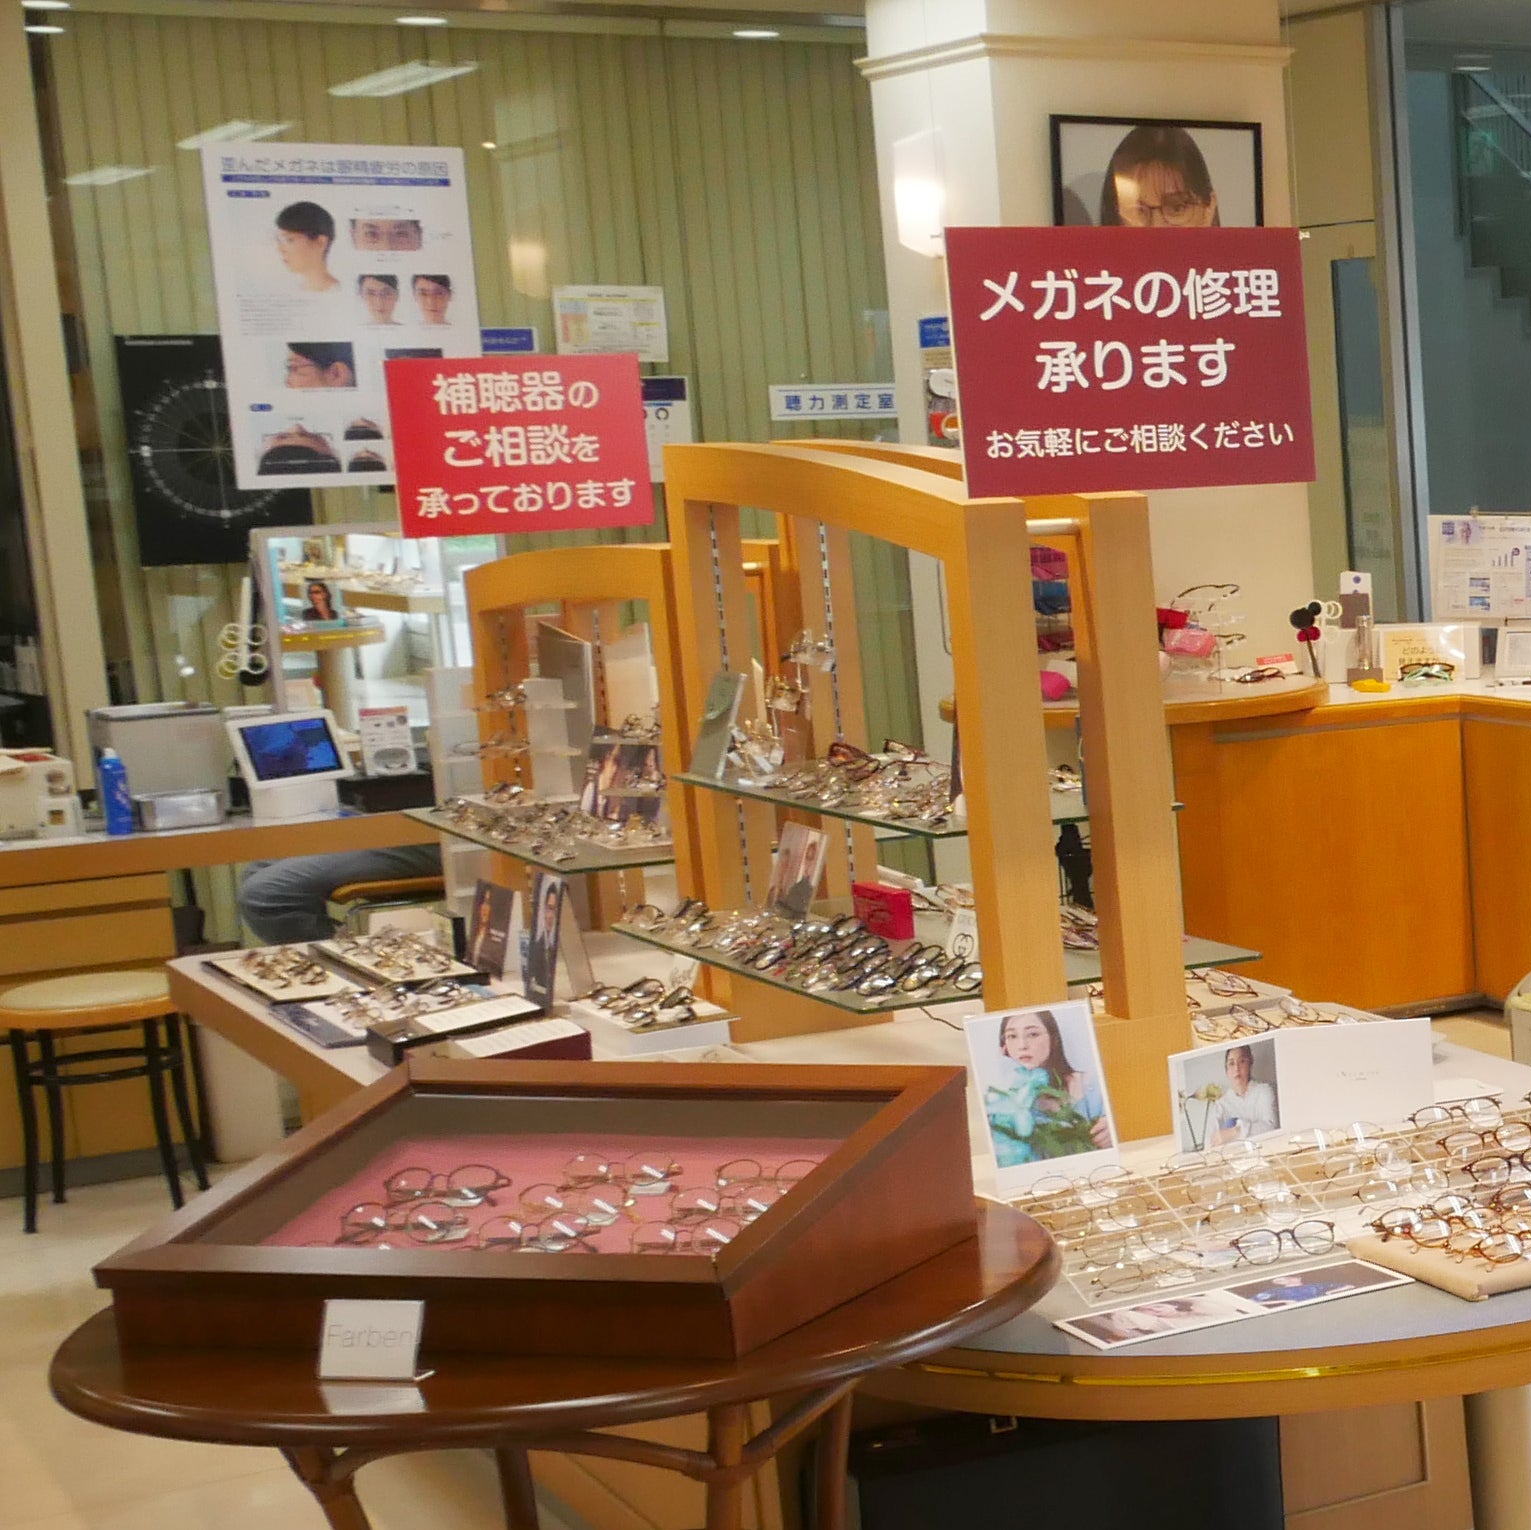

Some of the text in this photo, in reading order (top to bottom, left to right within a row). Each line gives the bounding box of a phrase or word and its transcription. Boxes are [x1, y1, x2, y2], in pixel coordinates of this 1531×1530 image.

[980, 267, 1282, 321] メガネの修理
[1034, 337, 1236, 394] 承ります
[431, 370, 600, 416] 補聴器の
[784, 393, 896, 412] 聴力測定室
[443, 424, 600, 468] ご相談を
[986, 420, 1294, 458] お気軽にご相談ください
[416, 478, 637, 519] 承っております
[326, 1324, 412, 1349] Farben
